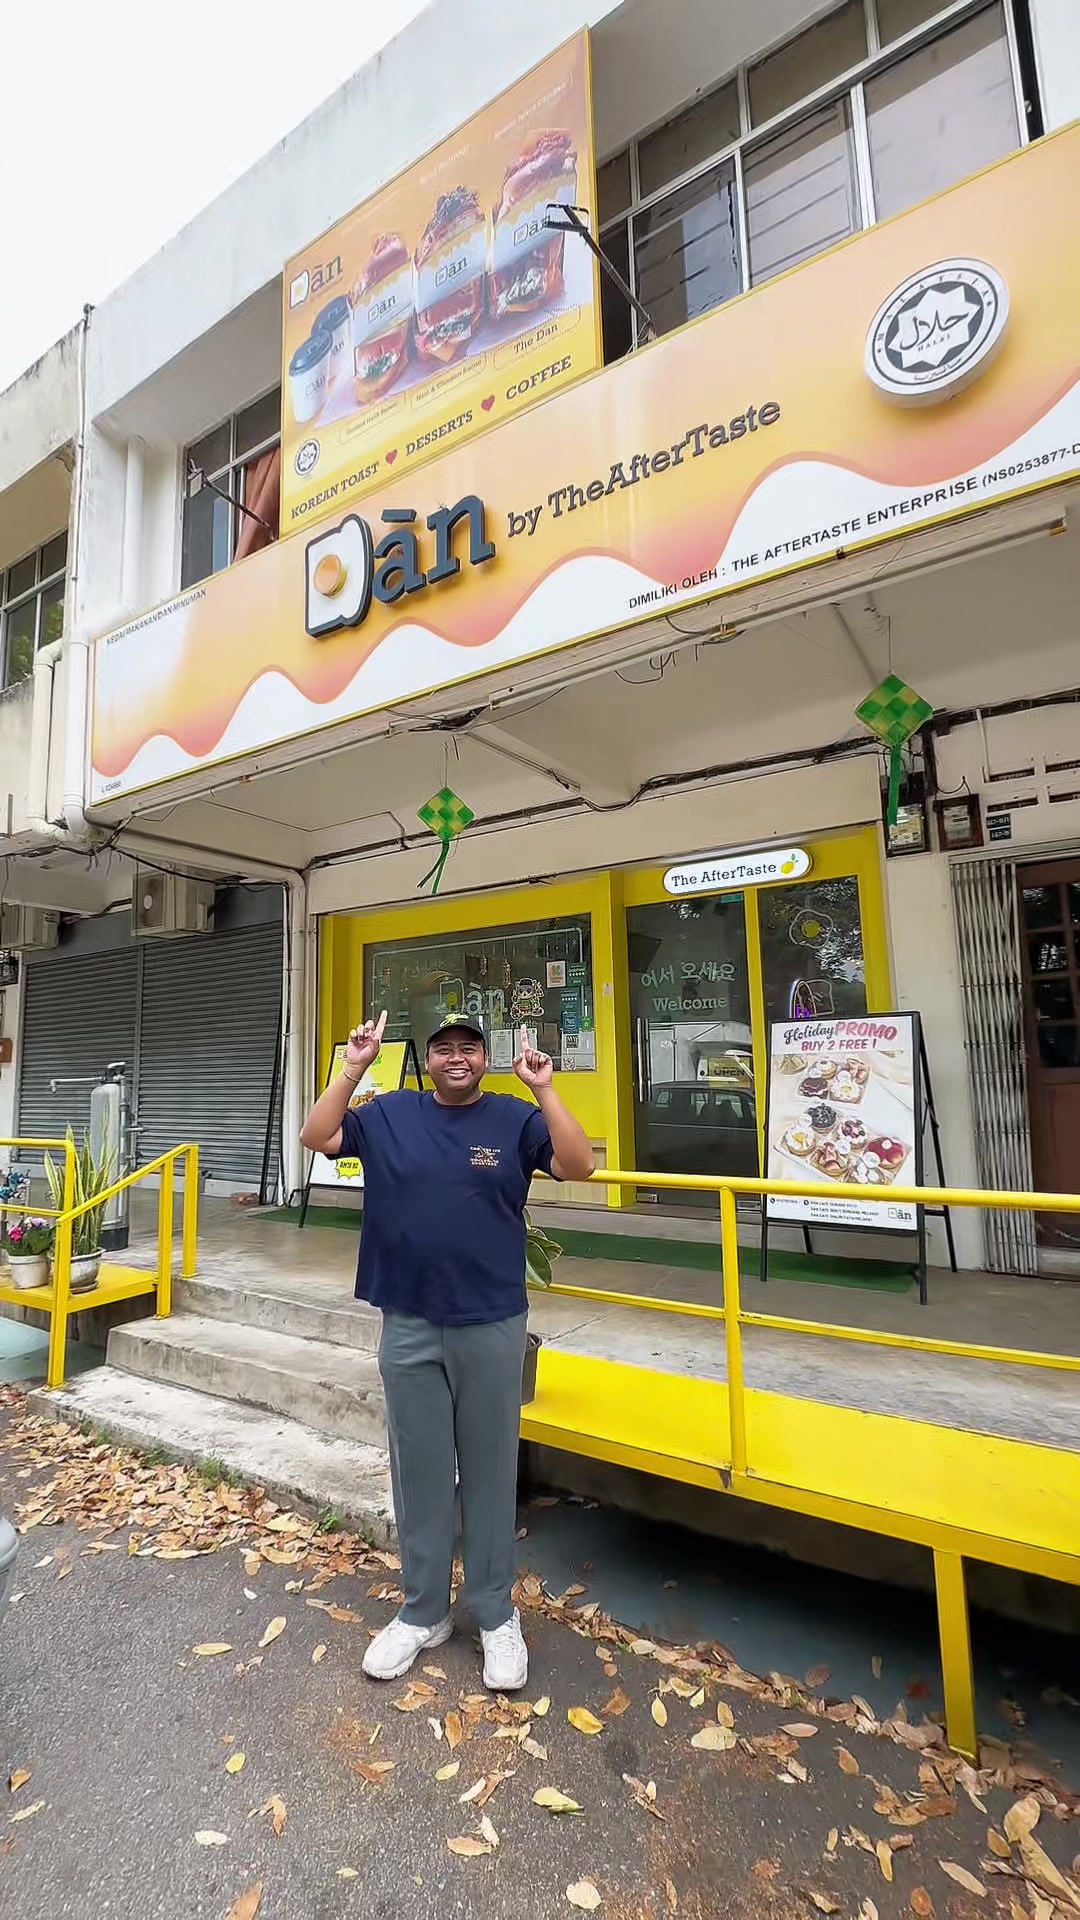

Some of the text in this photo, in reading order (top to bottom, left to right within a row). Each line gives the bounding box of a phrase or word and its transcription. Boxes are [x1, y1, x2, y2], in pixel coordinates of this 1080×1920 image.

[513, 336, 534, 354] The
[291, 483, 339, 519] KOREAN
[340, 462, 380, 493] TOAST
[406, 410, 473, 457] DESSERTS
[505, 354, 572, 400] COFFEE
[507, 400, 781, 538] by TheAfterTaste
[629, 583, 678, 609] DIMILIKI
[681, 568, 718, 589] OLEH
[731, 554, 759, 572] THE
[764, 518, 861, 561] AFTERTASTE
[867, 477, 979, 526] ENTERPRISE
[671, 863, 777, 887] The AfterTaste
[640, 960, 736, 988] 어서 오세요
[652, 995, 729, 1012] Welcome
[783, 1021, 898, 1045] Holiday PROMO
[801, 1040, 826, 1051] BUY
[827, 1039, 835, 1050] 2
[838, 1038, 869, 1049] FREE
